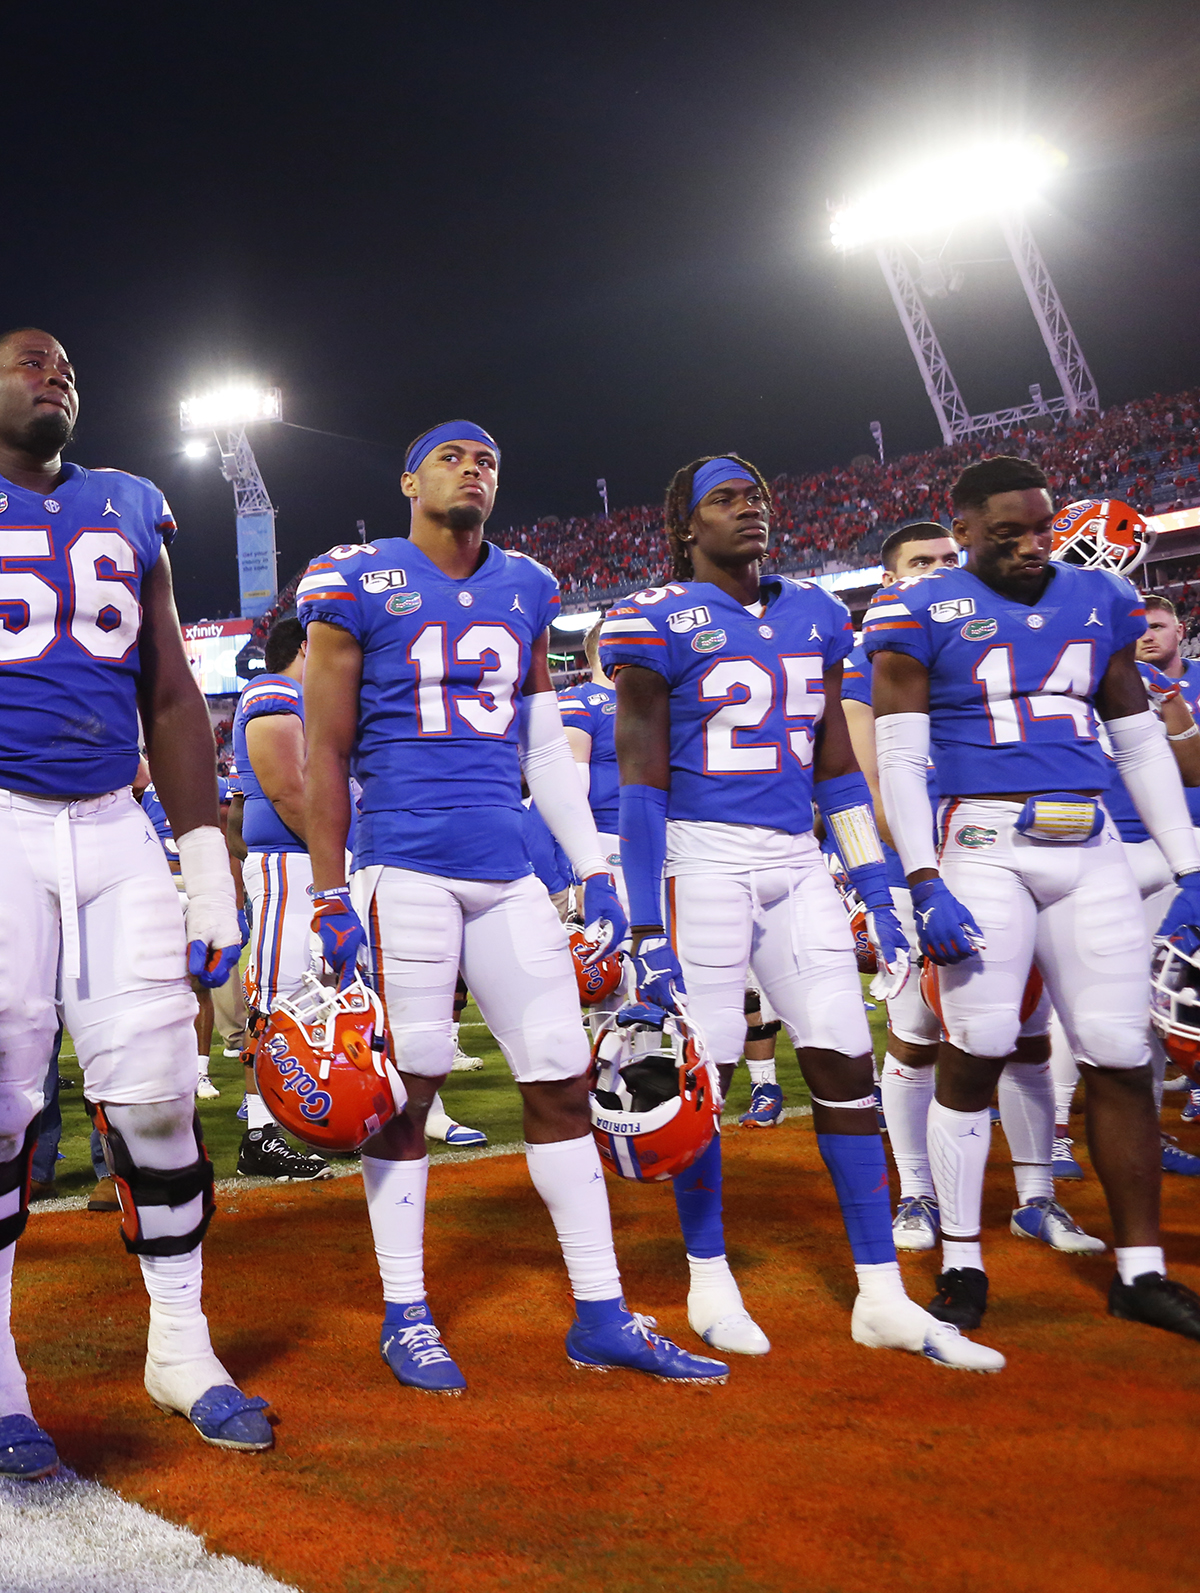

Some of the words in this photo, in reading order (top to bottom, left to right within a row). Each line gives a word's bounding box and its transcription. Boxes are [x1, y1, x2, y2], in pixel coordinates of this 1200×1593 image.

[359, 568, 408, 594] 150
[666, 605, 712, 634] 150
[928, 597, 976, 623] 150
[185, 624, 224, 641] xfinity
[407, 621, 526, 738] 13
[972, 639, 1098, 746] 14
[698, 652, 824, 776] 25
[268, 1033, 332, 1121] Gators
[596, 1116, 641, 1134] FLORIDA
